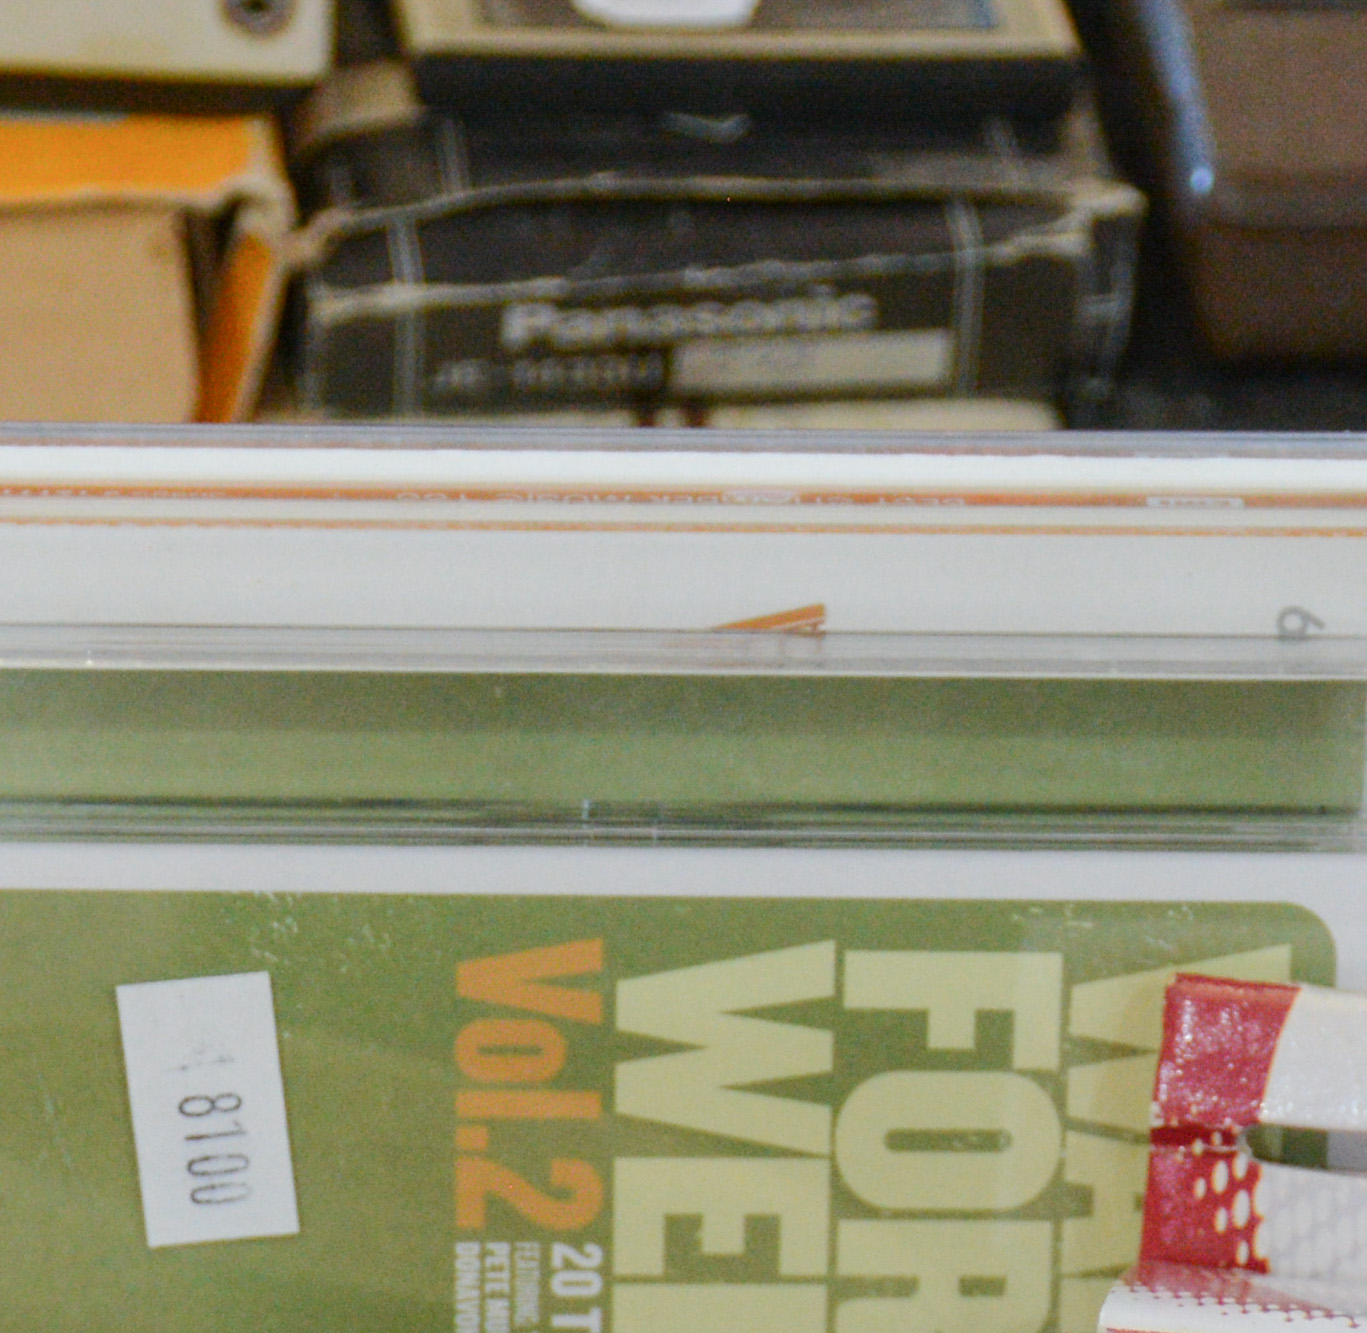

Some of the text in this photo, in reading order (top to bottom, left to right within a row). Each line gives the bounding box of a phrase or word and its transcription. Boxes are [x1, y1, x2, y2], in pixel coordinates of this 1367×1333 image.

[500, 285, 880, 350] Panasonic
[454, 937, 605, 1231] Vol.2
[178, 1092, 251, 1205] 8100
[484, 1242, 510, 1294] PETE
[550, 1241, 603, 1298] 20
